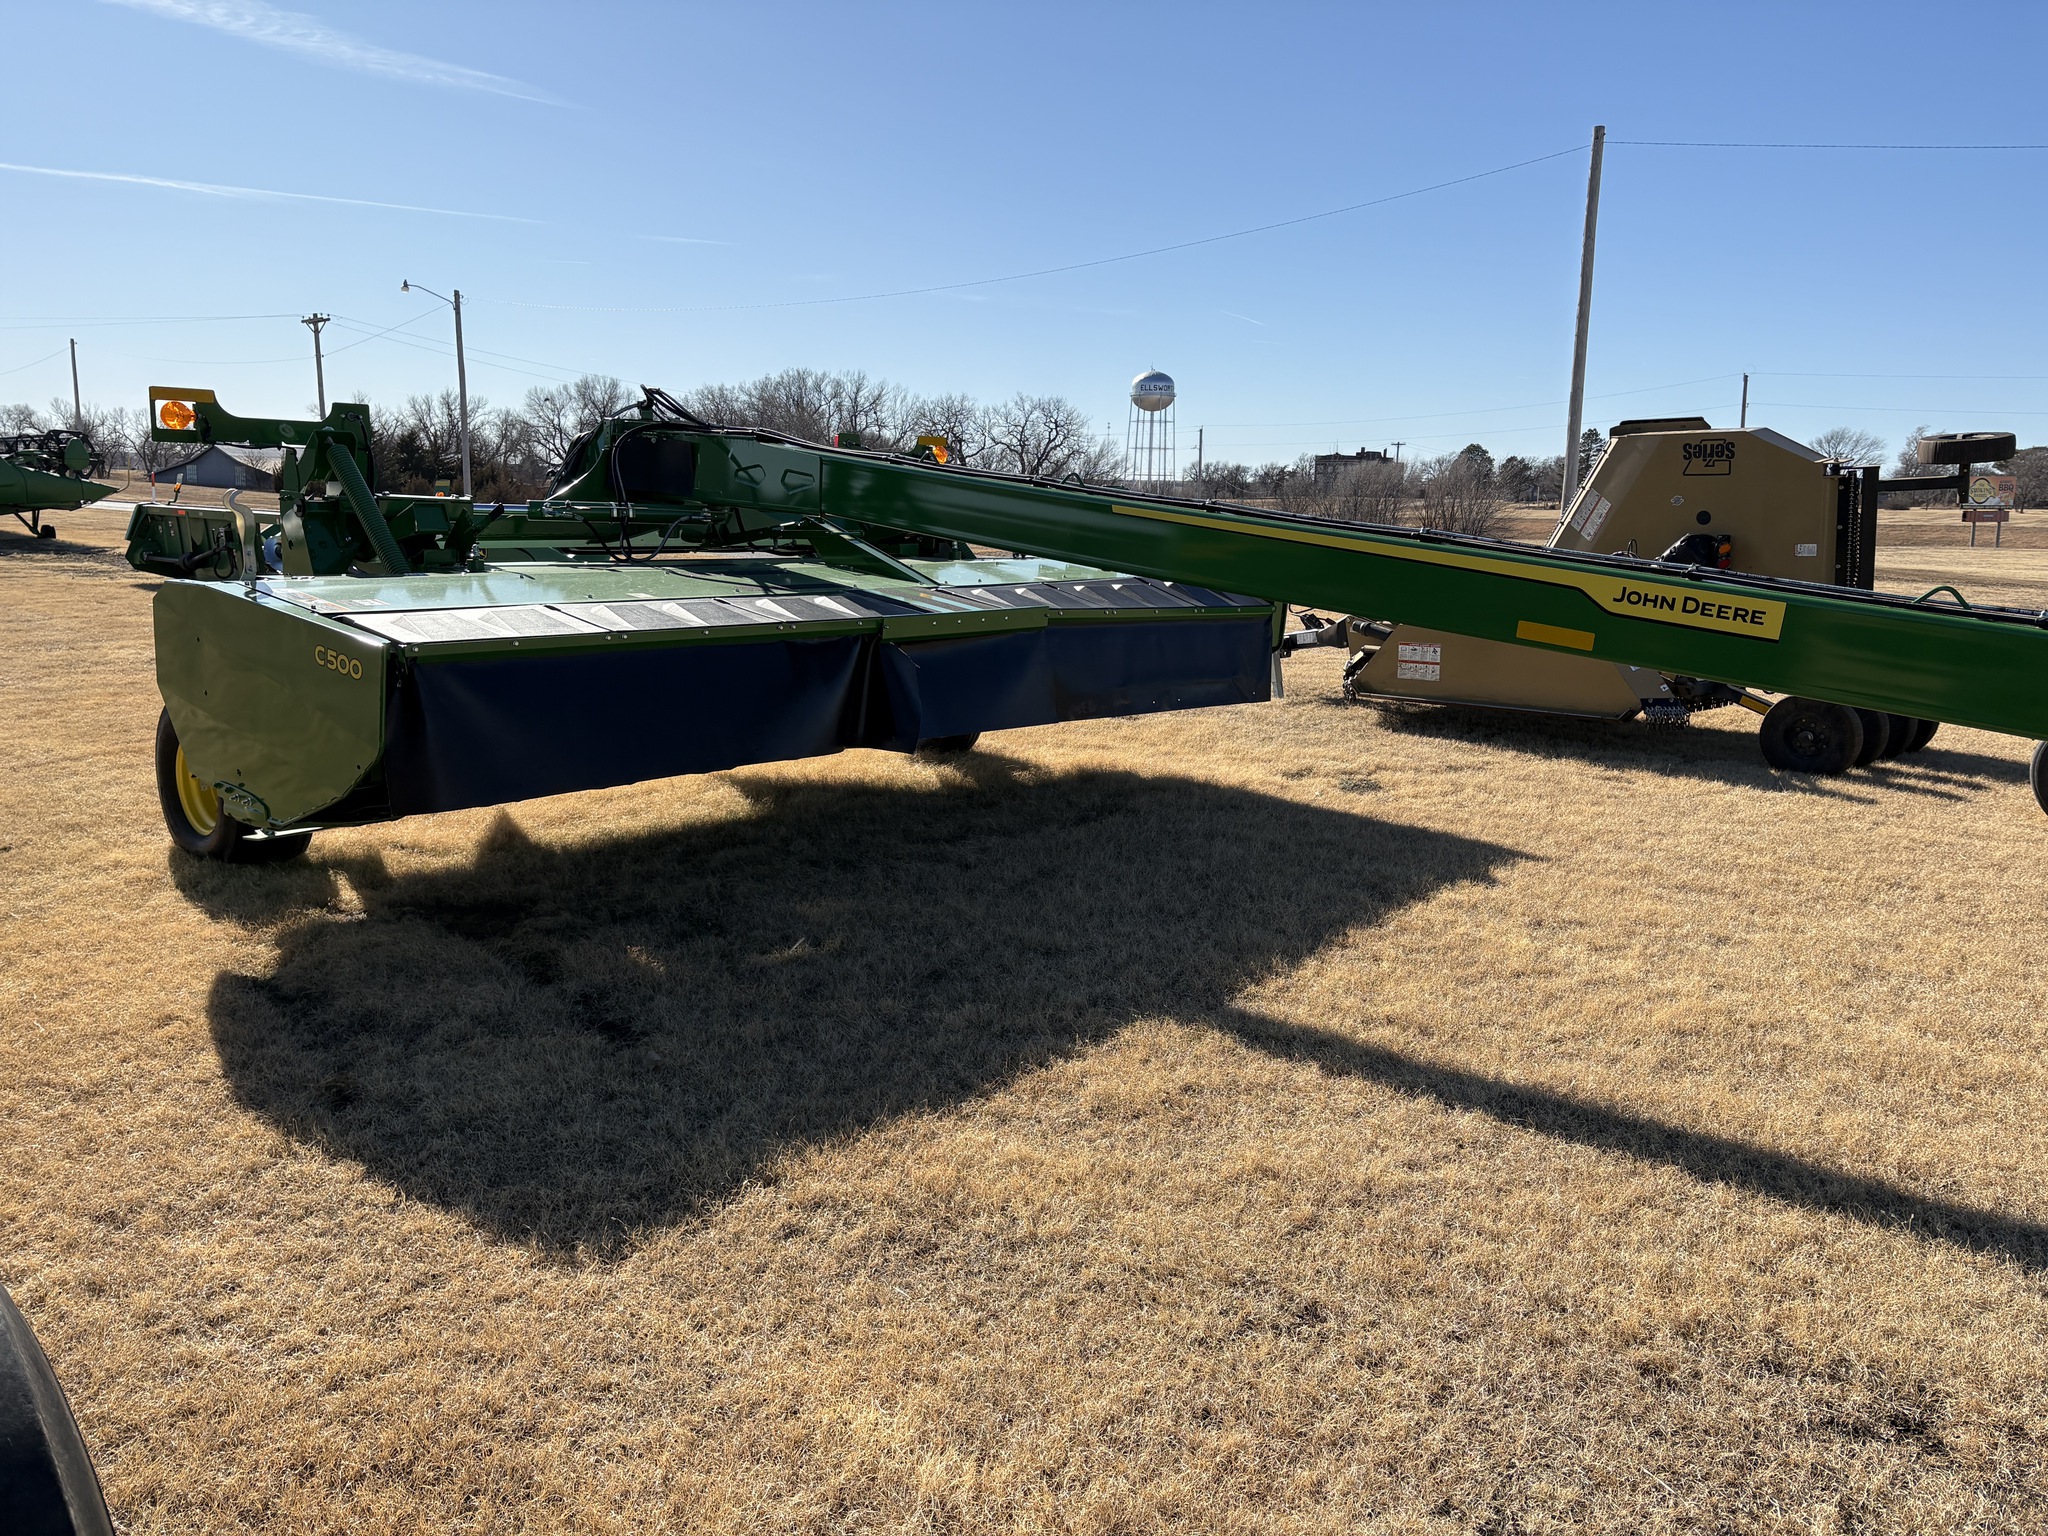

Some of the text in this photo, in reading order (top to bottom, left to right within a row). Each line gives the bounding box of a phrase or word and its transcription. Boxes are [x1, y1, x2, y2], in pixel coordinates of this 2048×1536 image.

[1682, 441, 1736, 462] Series
[1998, 483, 2015, 493] BBQ
[1612, 586, 1767, 626] JOHN DEERE
[314, 644, 363, 681] C500
